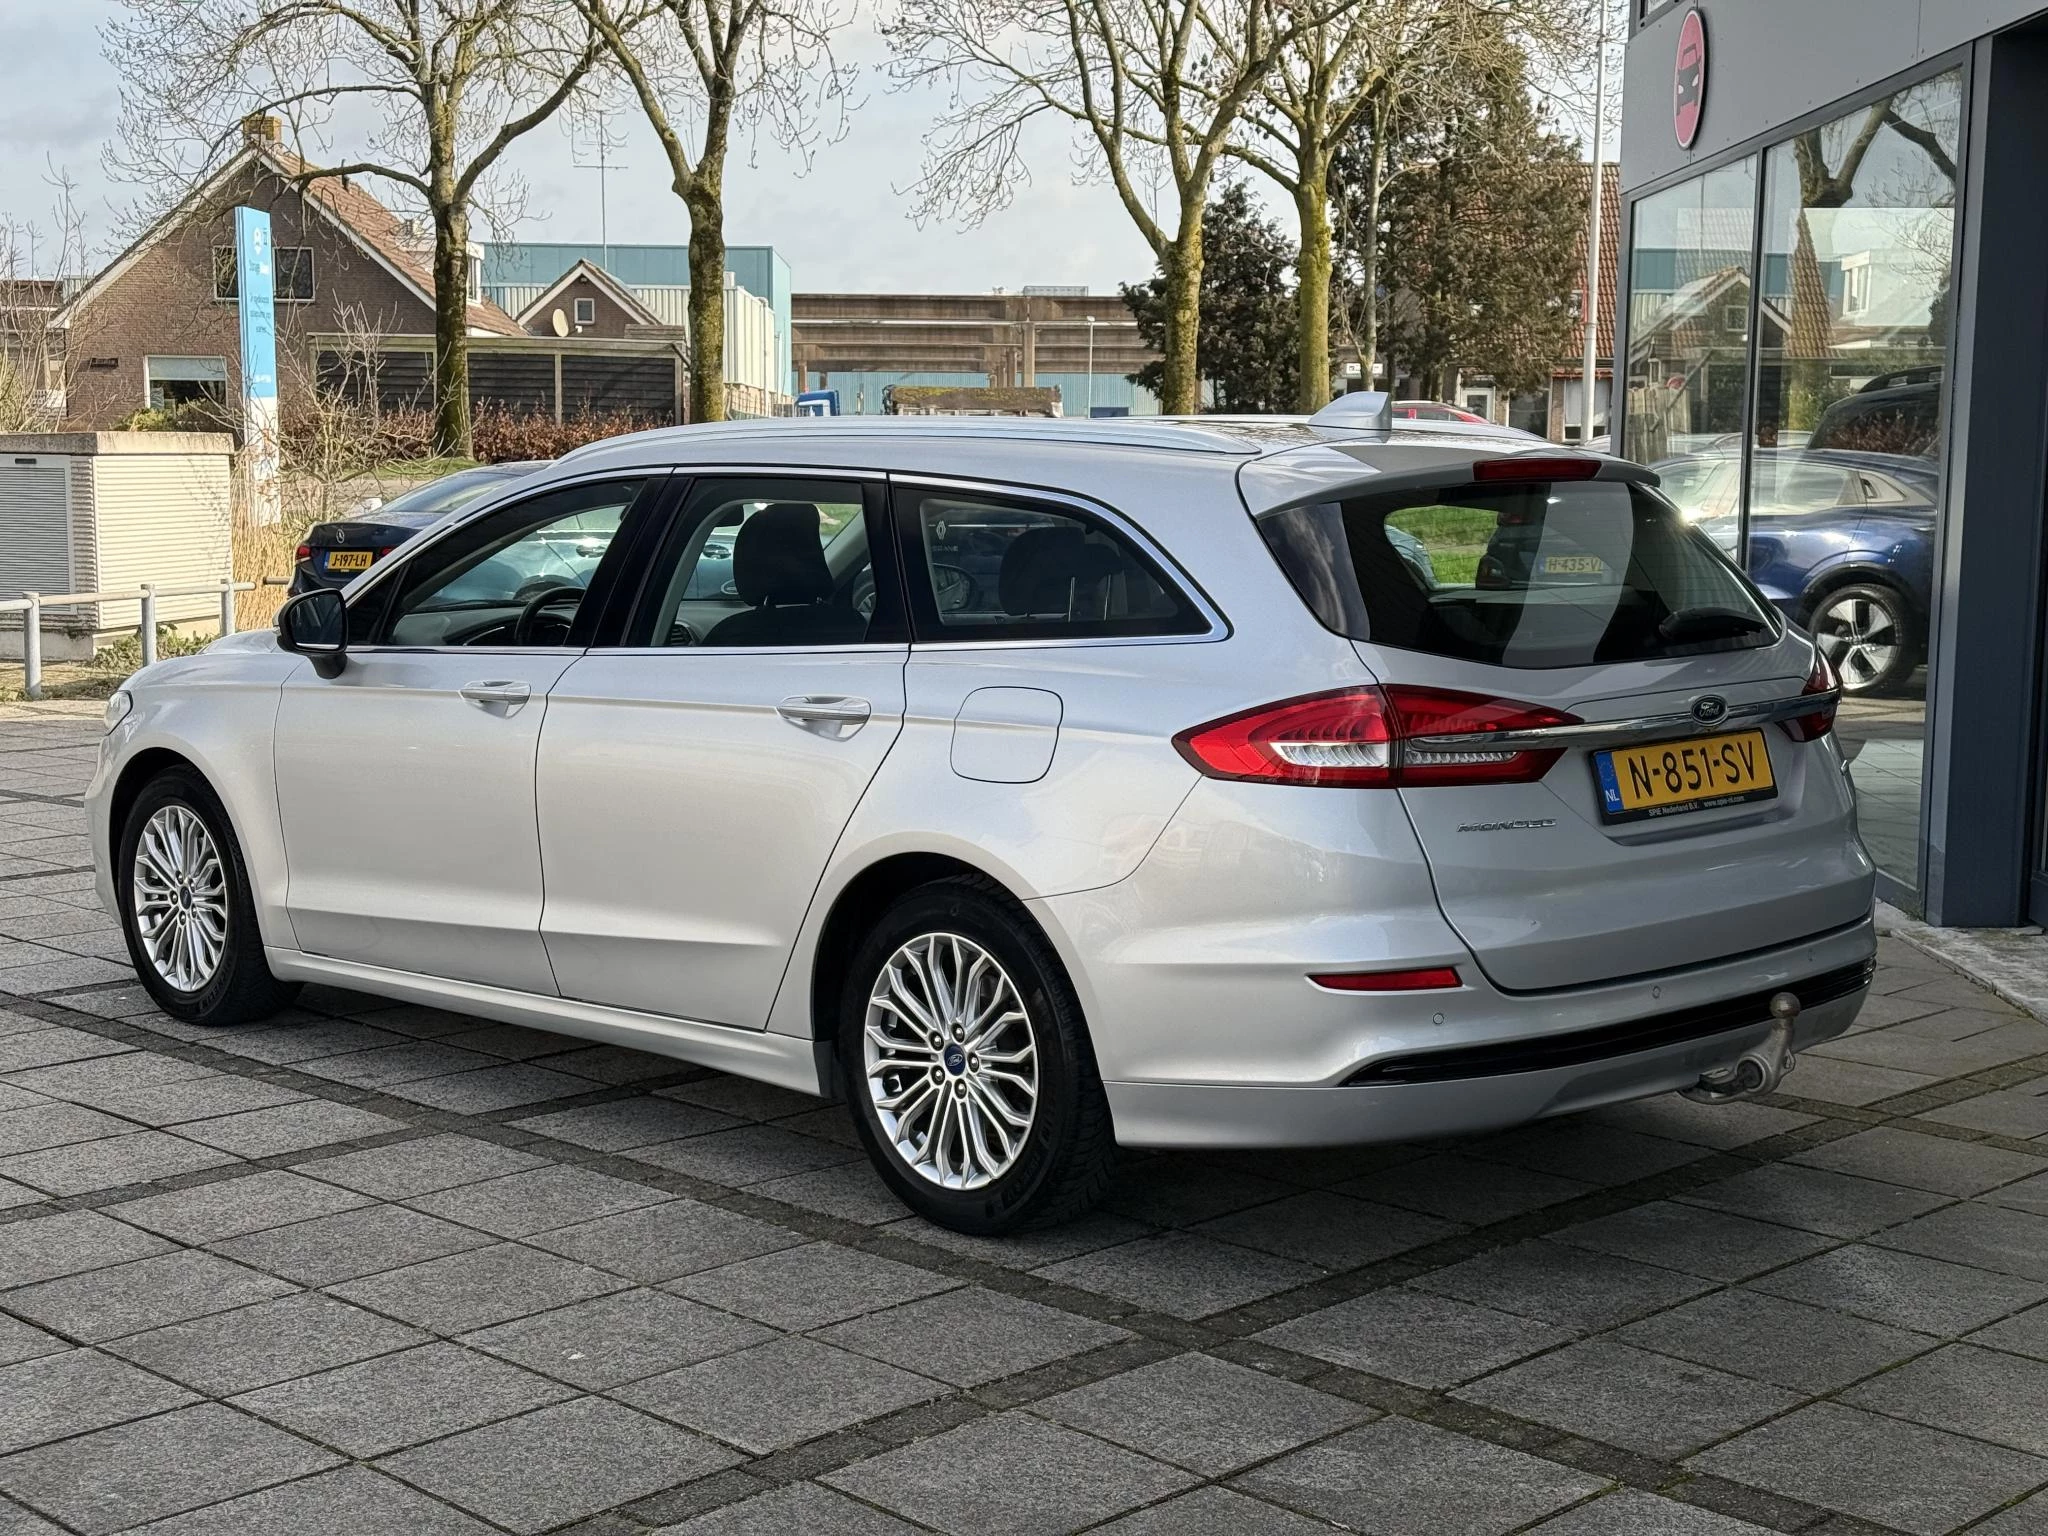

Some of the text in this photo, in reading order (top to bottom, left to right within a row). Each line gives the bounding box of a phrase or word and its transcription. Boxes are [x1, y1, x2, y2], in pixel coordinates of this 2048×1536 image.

[332, 554, 368, 567] J-197-LH
[1699, 701, 1720, 717] Ford
[1628, 741, 1755, 799] N-851-SV
[1605, 789, 1620, 802] NL
[1662, 802, 1689, 815] Nederland
